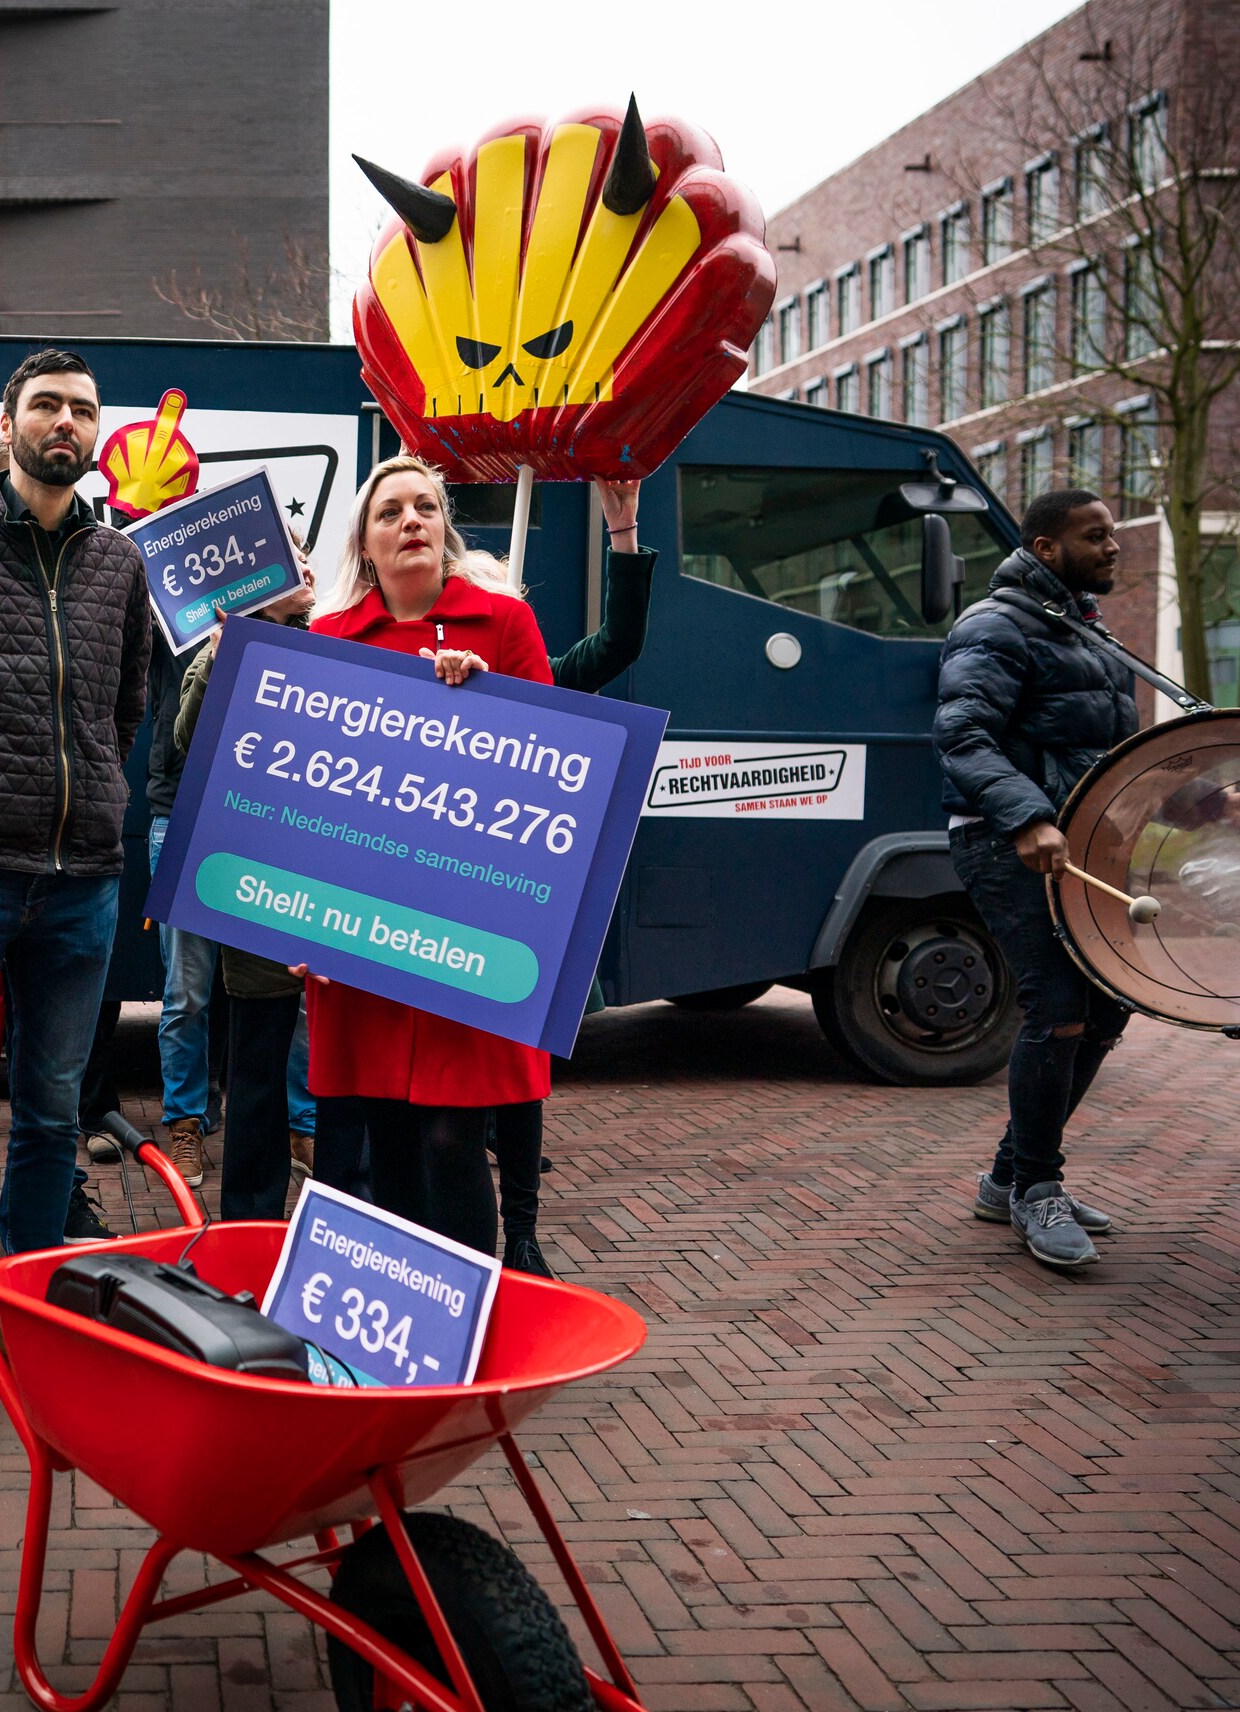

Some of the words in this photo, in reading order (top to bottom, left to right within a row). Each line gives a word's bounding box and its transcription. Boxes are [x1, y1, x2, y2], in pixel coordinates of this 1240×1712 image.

[143, 494, 262, 558] Energierekening
[162, 564, 184, 597] €
[184, 534, 267, 585] 334,-
[185, 602, 211, 623] Shell:
[227, 574, 271, 601] betalen
[254, 669, 592, 793] Energierekening
[679, 757, 701, 769] TIJD
[704, 754, 732, 767] VOOR
[233, 732, 262, 769] €
[266, 740, 577, 854] 2.624.543.276
[668, 763, 826, 795] RECHTVAARDIGHEID
[735, 801, 766, 812] SAMEN
[769, 798, 797, 809] STAAN
[799, 796, 814, 806] WE
[816, 795, 828, 805] OP
[223, 790, 276, 820] Naar:
[280, 805, 409, 858] Nederlandse
[414, 848, 551, 904] samenleving
[235, 874, 316, 922] Shell:
[322, 906, 363, 937] nu
[368, 915, 486, 976] betalen
[309, 1218, 466, 1318] Energierekening
[301, 1272, 333, 1324] €
[335, 1287, 440, 1384] 334,-
